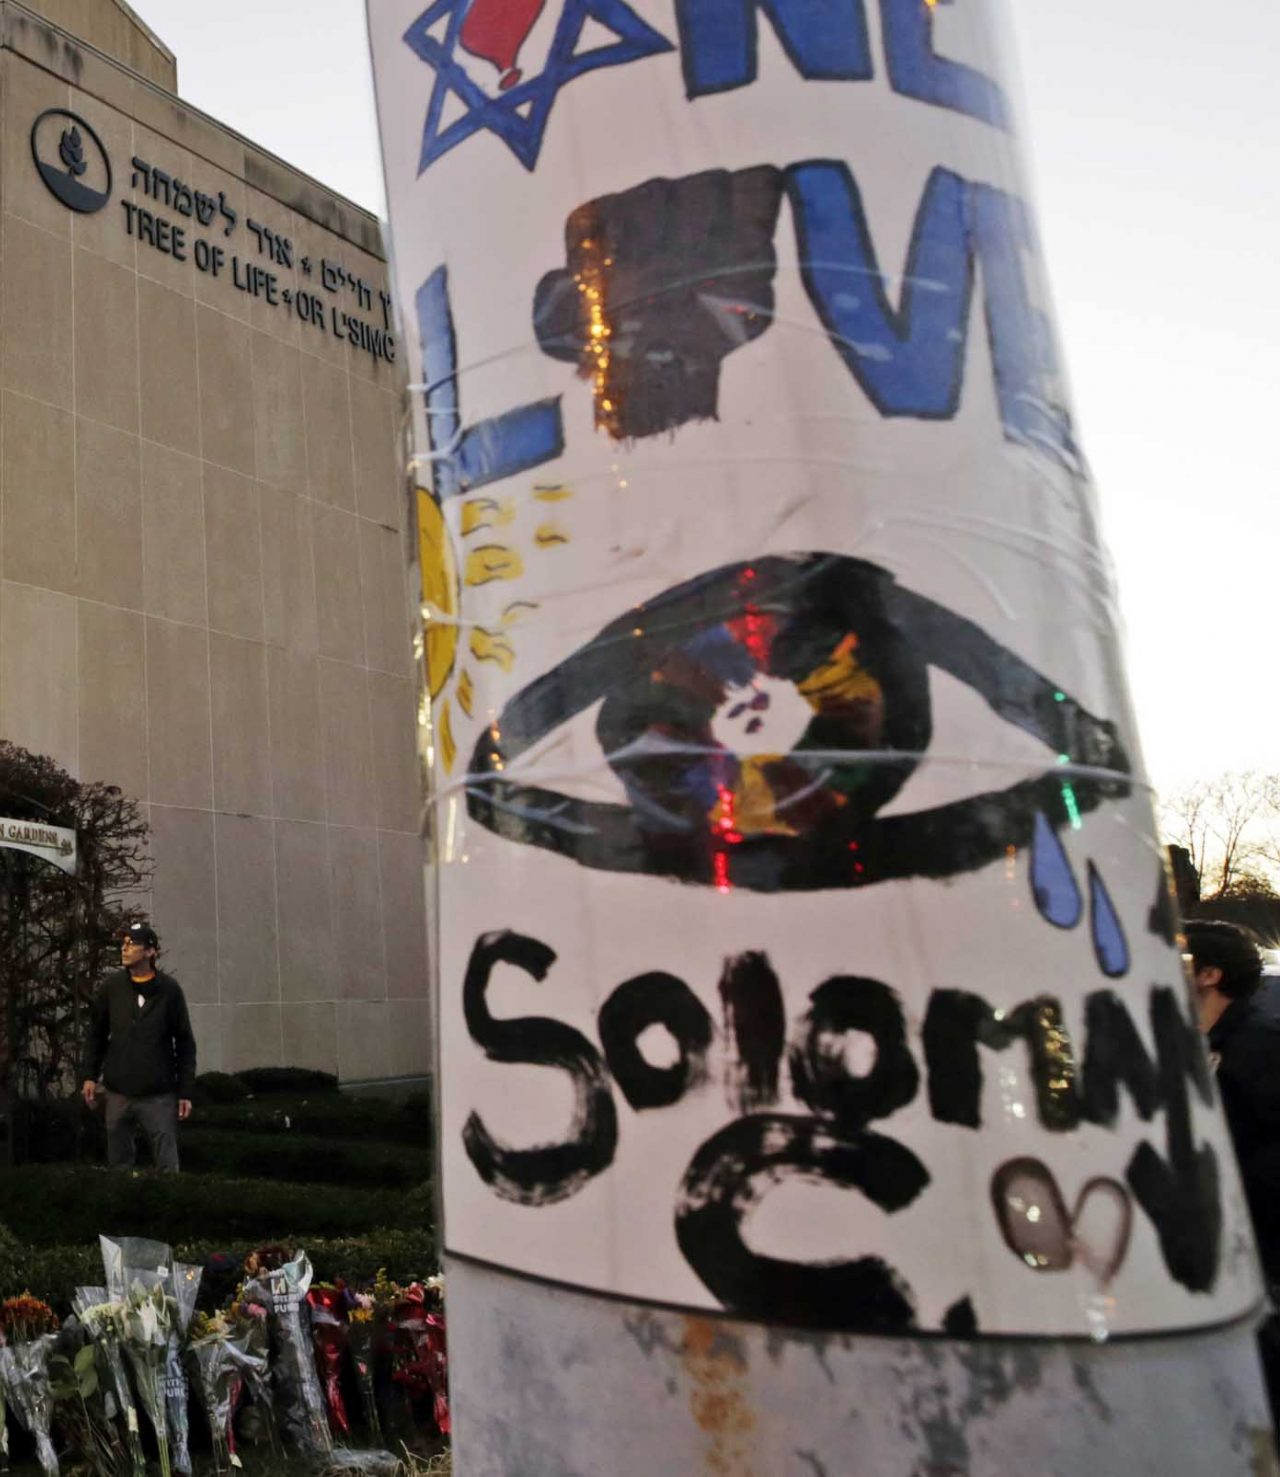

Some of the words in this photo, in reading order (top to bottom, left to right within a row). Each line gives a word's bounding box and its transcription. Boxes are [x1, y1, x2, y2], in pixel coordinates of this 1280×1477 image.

[131, 156, 236, 236] לשמחה
[121, 200, 186, 261] TREE
[194, 238, 225, 277] OF
[232, 256, 280, 306] LIFE
[296, 289, 326, 329] OR
[247, 218, 293, 266] אור
[8, 825, 58, 844] GARDENS
